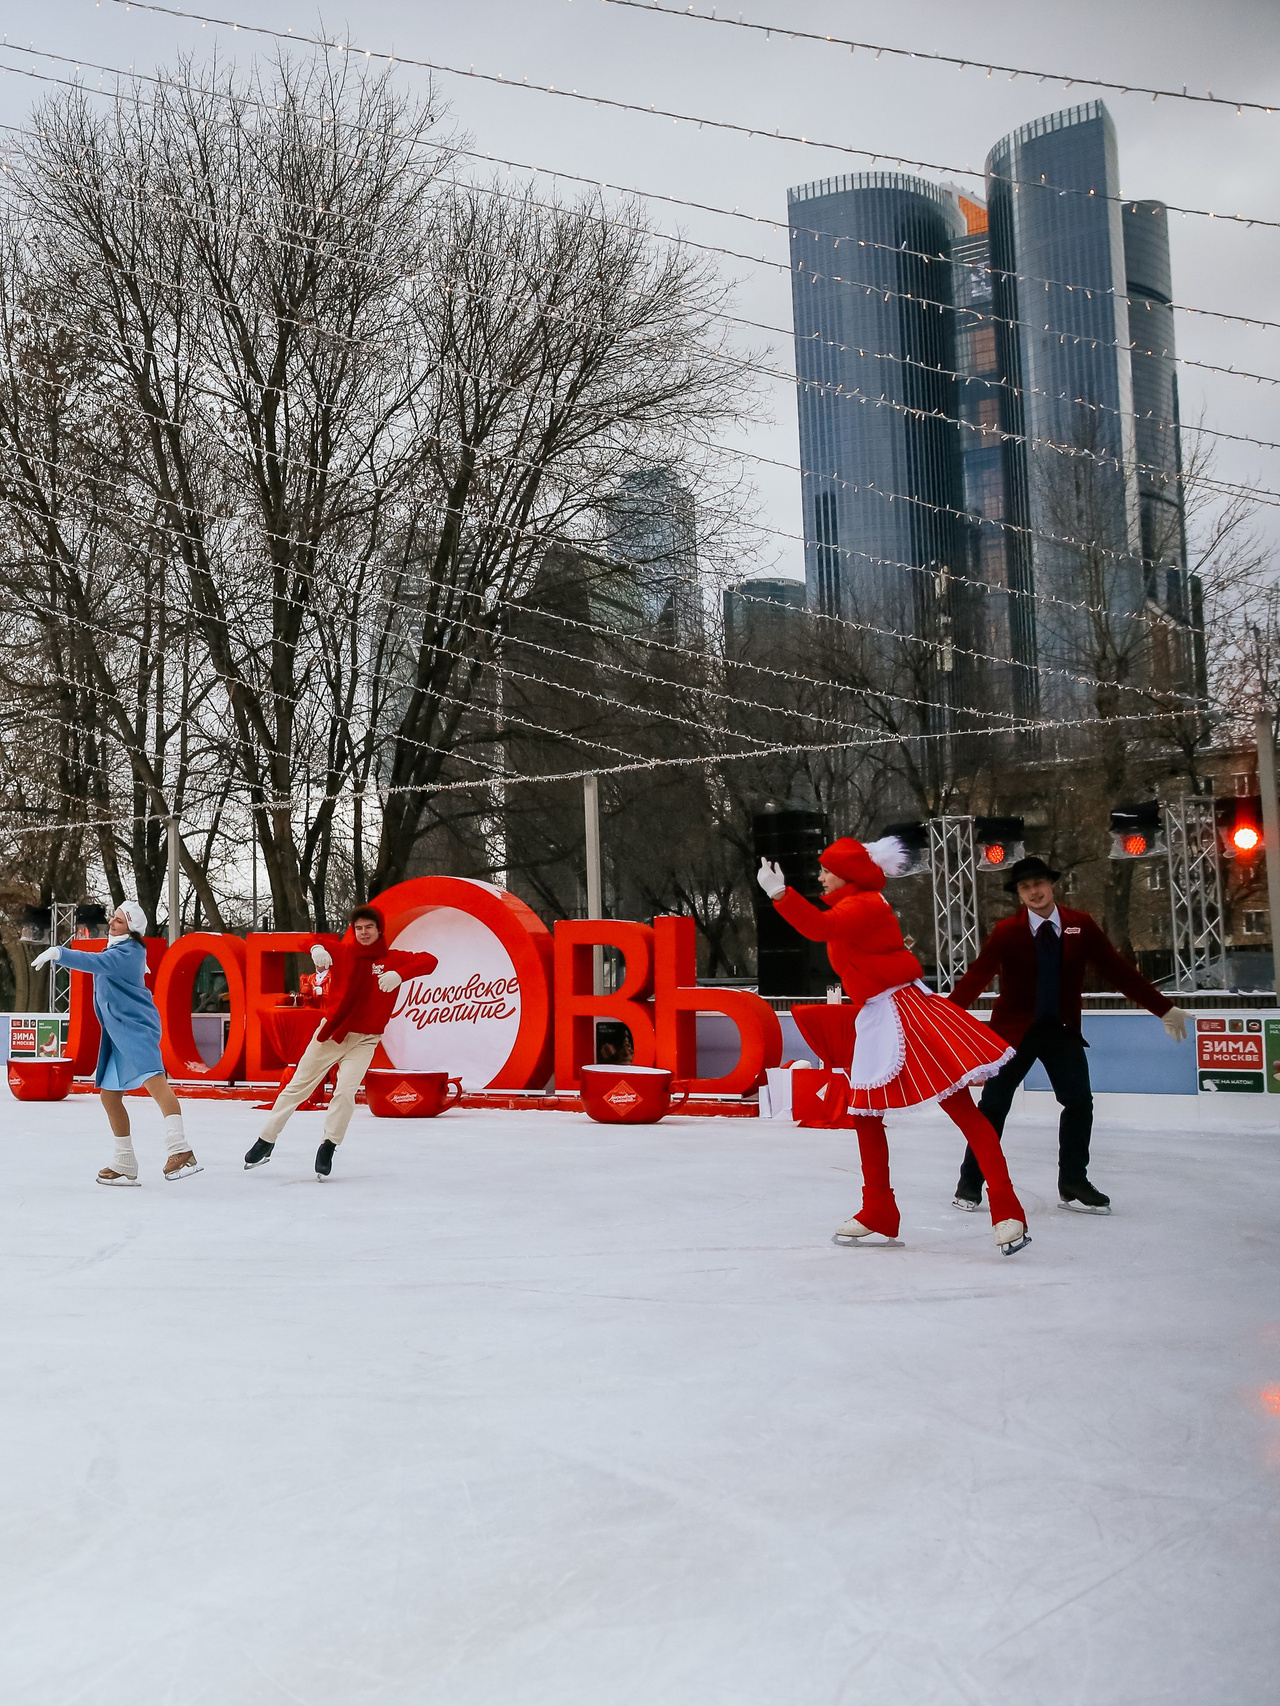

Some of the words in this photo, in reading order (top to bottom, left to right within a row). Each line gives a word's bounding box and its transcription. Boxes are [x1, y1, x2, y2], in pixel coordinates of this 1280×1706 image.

[391, 973, 519, 1019] Московское
[12, 1032, 35, 1041] ЗИМА
[1203, 1041, 1258, 1053] ЗИМА
